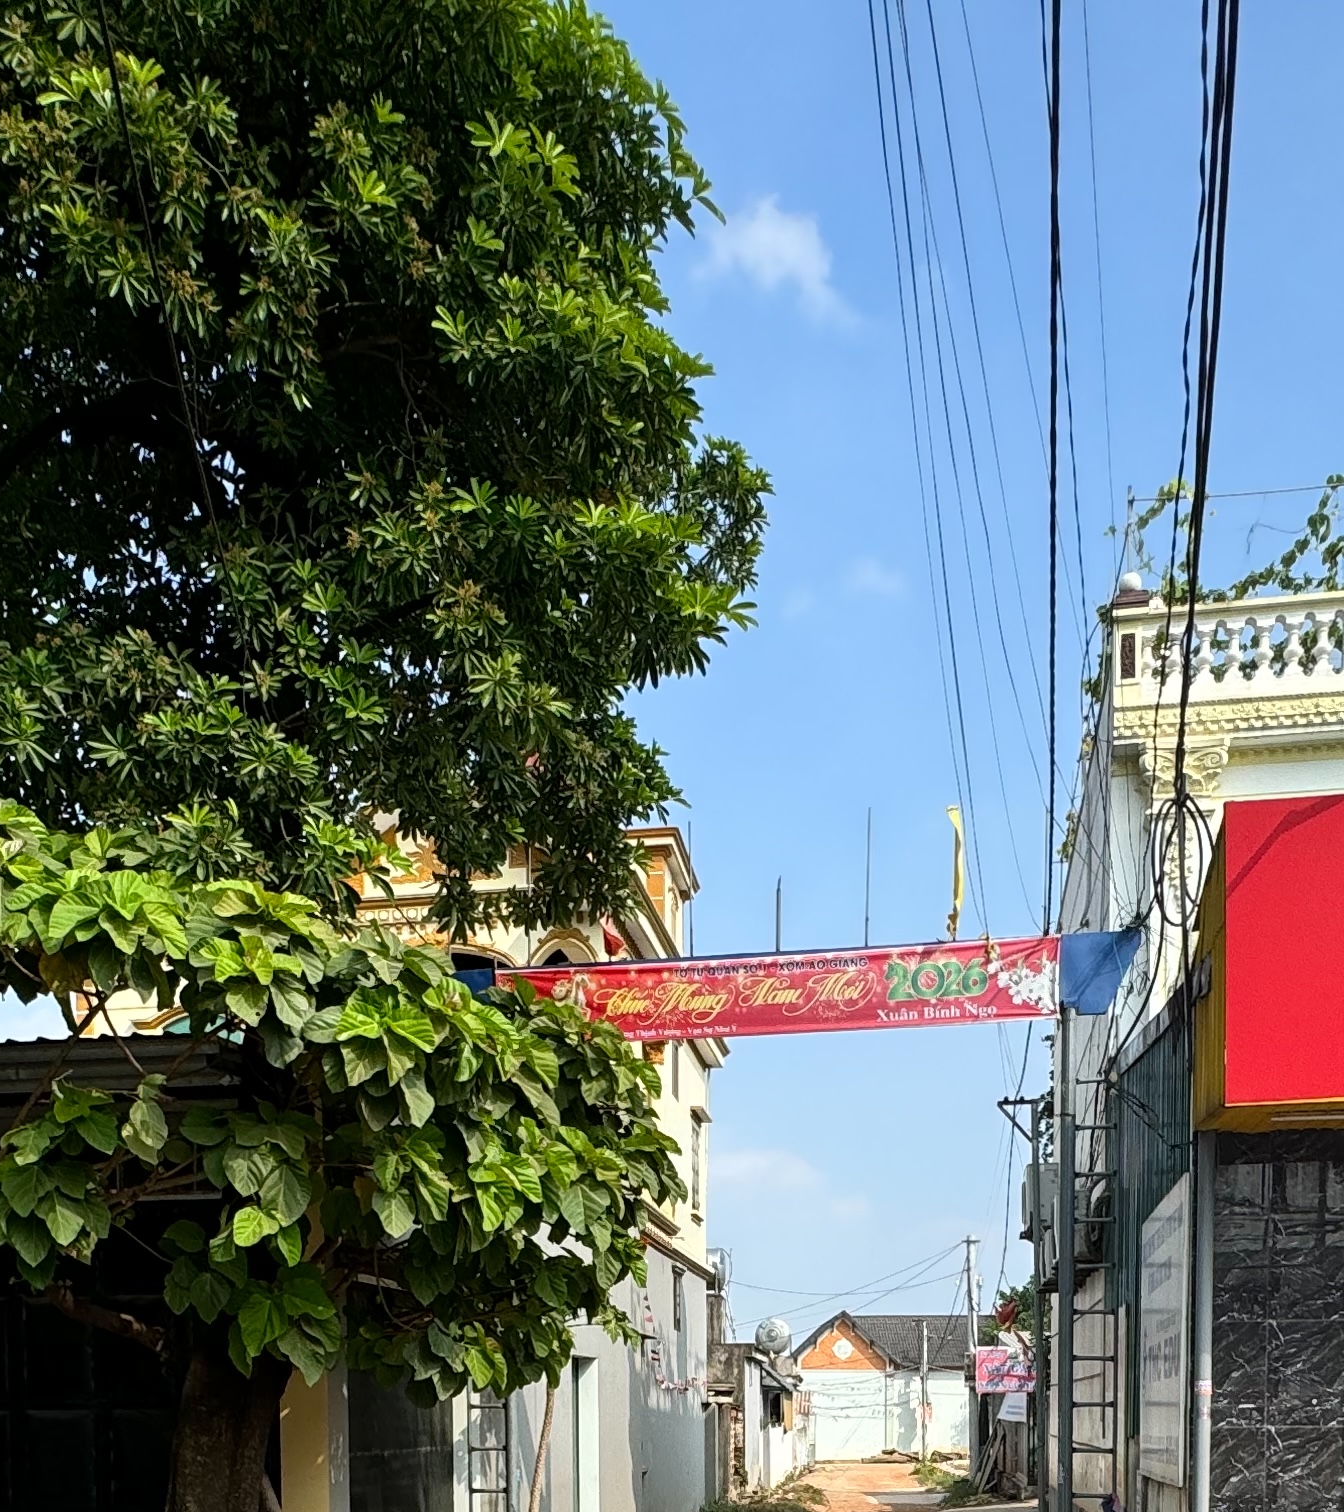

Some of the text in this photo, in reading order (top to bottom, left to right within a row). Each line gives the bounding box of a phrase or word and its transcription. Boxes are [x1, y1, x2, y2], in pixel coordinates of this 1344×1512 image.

[828, 957, 868, 969] GIANG
[884, 958, 988, 1002] 2026
[876, 1000, 997, 1023] Xuân Bính Ngọ
